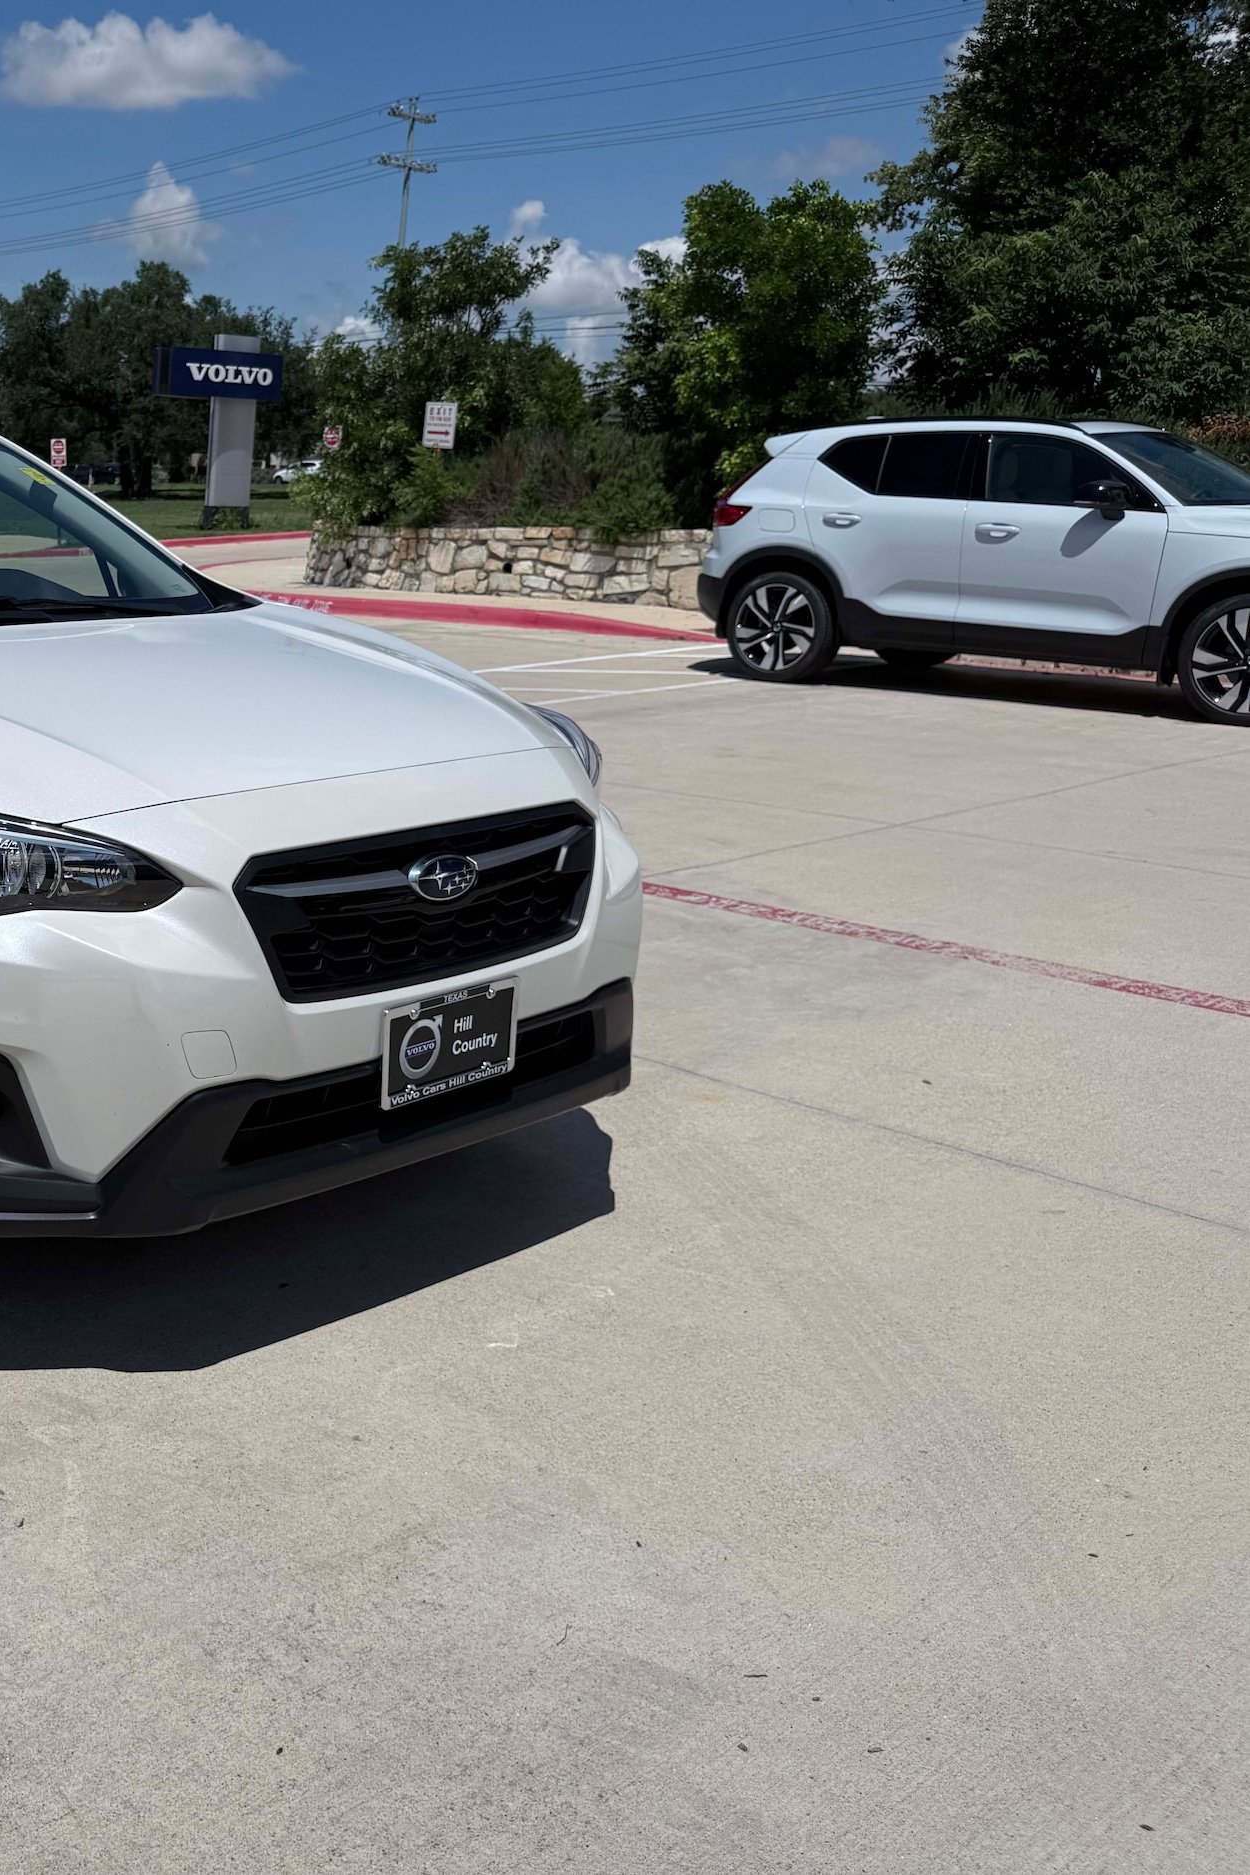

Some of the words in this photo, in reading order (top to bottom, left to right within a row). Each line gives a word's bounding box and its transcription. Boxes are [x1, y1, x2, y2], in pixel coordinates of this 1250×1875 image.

[186, 362, 273, 386] VOLVO
[430, 407, 453, 416] EXIT
[443, 990, 468, 1003] TEXAS
[453, 1015, 473, 1033] Hill
[406, 1042, 435, 1056] VOLVO
[452, 1033, 498, 1055] Country
[391, 1090, 420, 1105] Volvo
[422, 1082, 446, 1096] Cars
[449, 1075, 466, 1088] Hill
[468, 1063, 508, 1082] Country
